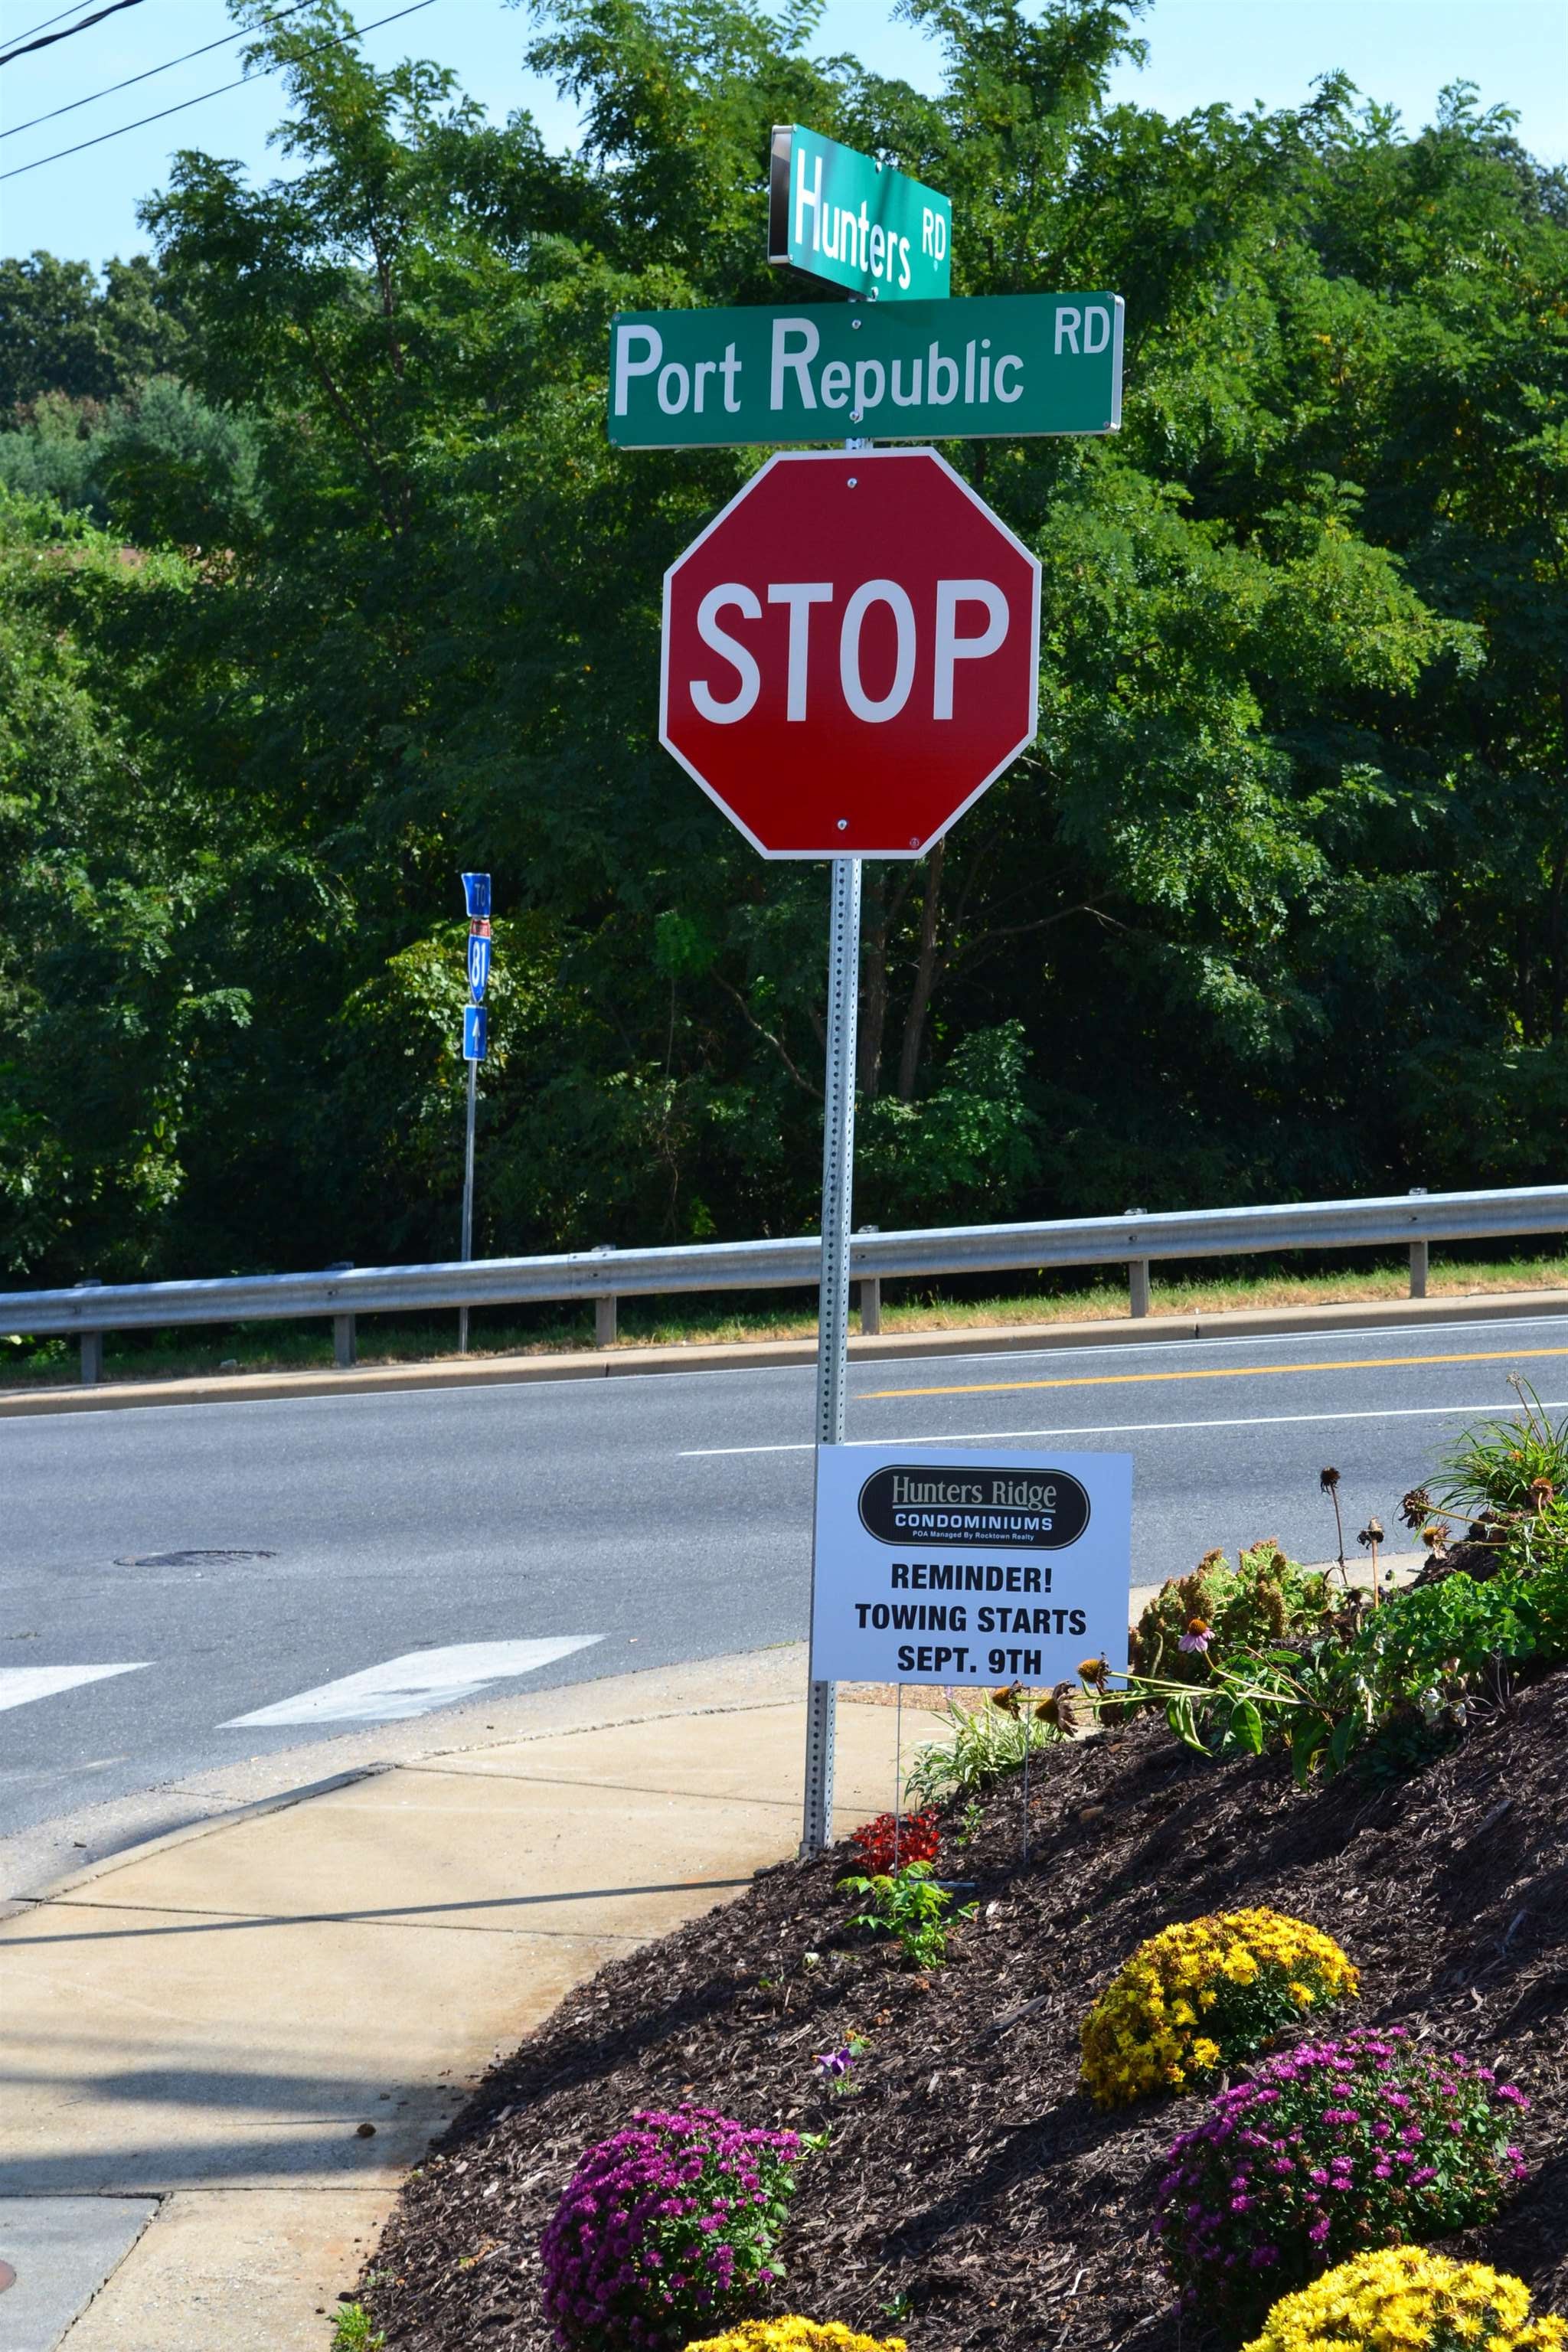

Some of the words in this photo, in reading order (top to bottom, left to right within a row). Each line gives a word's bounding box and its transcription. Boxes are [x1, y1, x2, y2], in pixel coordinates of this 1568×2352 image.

[794, 147, 911, 290] Hunters
[921, 207, 946, 262] RD
[614, 324, 742, 416] Port
[769, 317, 1024, 424] Republic
[1054, 305, 1111, 355] RD
[689, 579, 1010, 724] STOP
[475, 884, 486, 906] TO
[472, 941, 486, 988] 81
[892, 1475, 983, 1504] Hunters
[991, 1480, 1057, 1511] Ridge
[895, 1513, 1053, 1531] CONDOMINIUMS
[930, 1530, 962, 1539] Managed
[891, 1563, 1053, 1593] REMINDER!
[855, 1603, 966, 1632] TOWING
[977, 1607, 1086, 1635] STARTS
[897, 1645, 976, 1673] SEPT.
[988, 1648, 1042, 1675] 9TH
